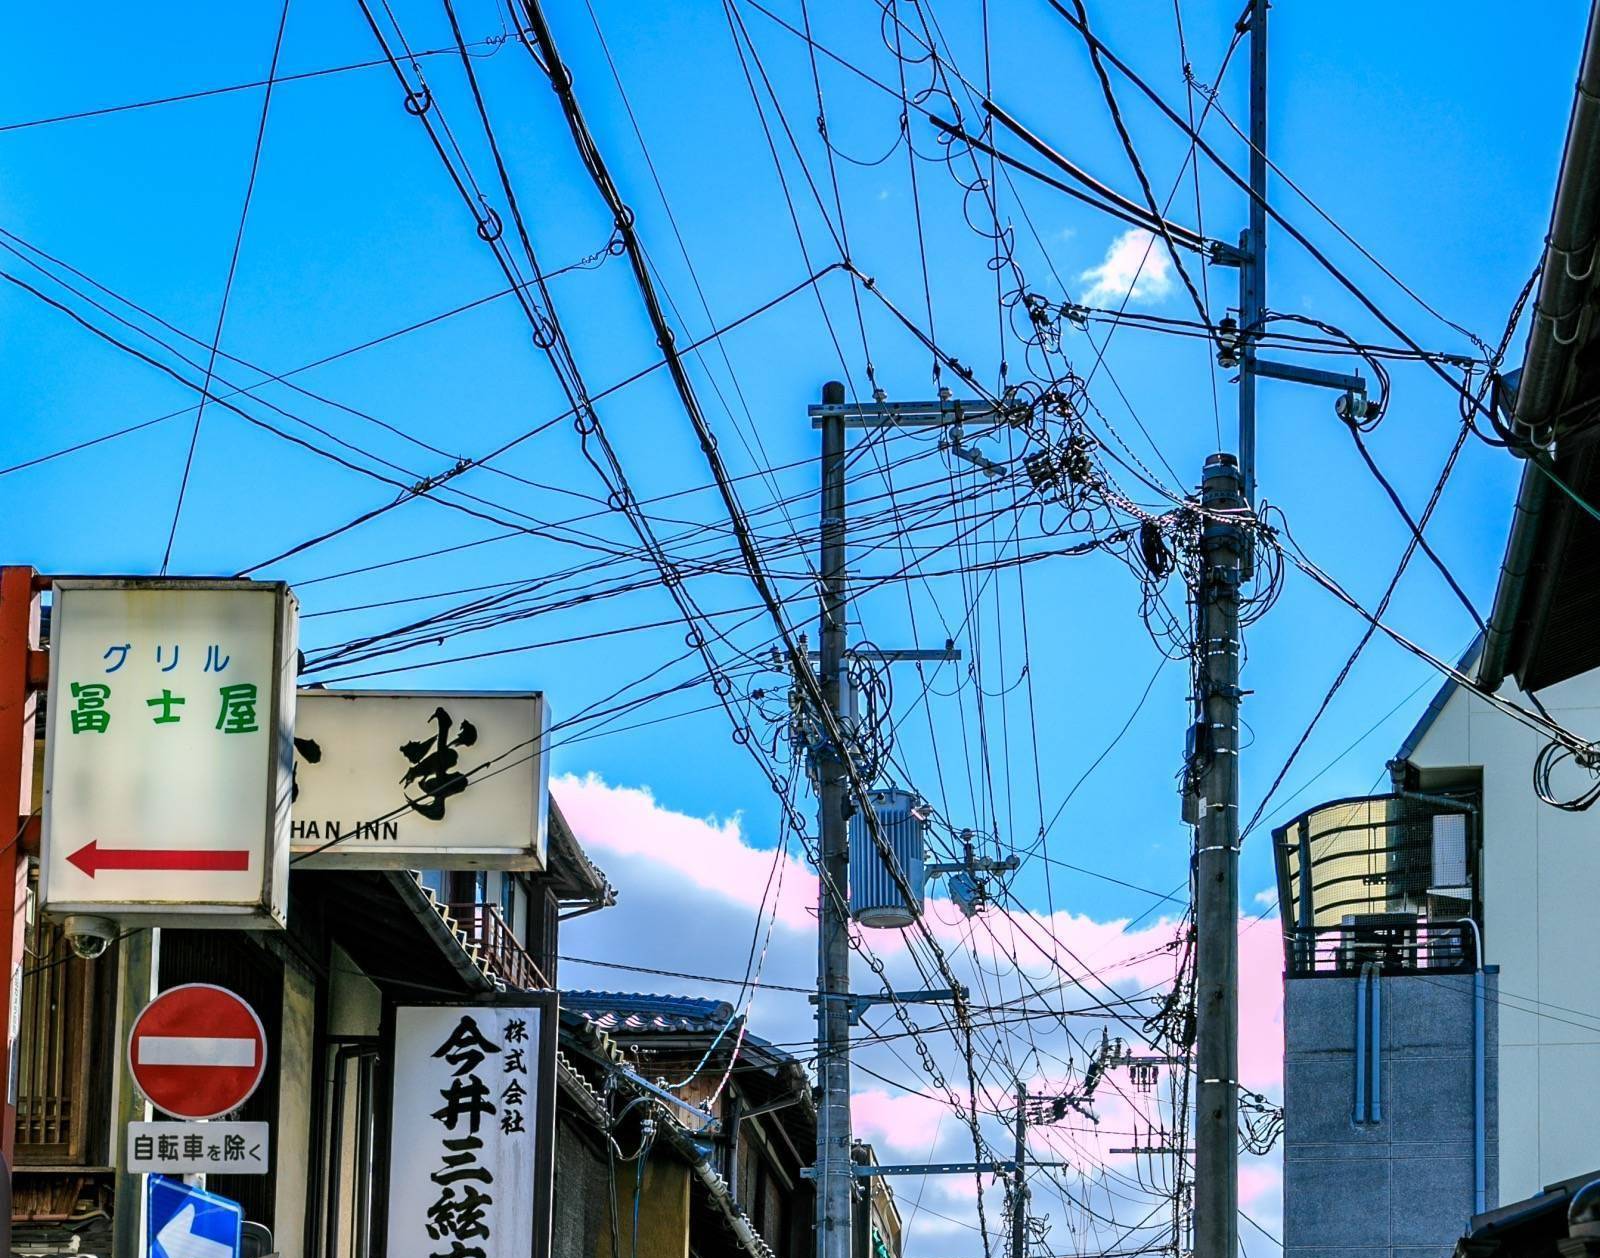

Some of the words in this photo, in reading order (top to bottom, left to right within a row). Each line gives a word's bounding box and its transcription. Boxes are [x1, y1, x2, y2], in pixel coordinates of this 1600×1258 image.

[103, 643, 230, 673] グリル
[356, 821, 398, 841] INN
[500, 1018, 529, 1135] 株式会社
[134, 1134, 262, 1163] 自転車を除く
